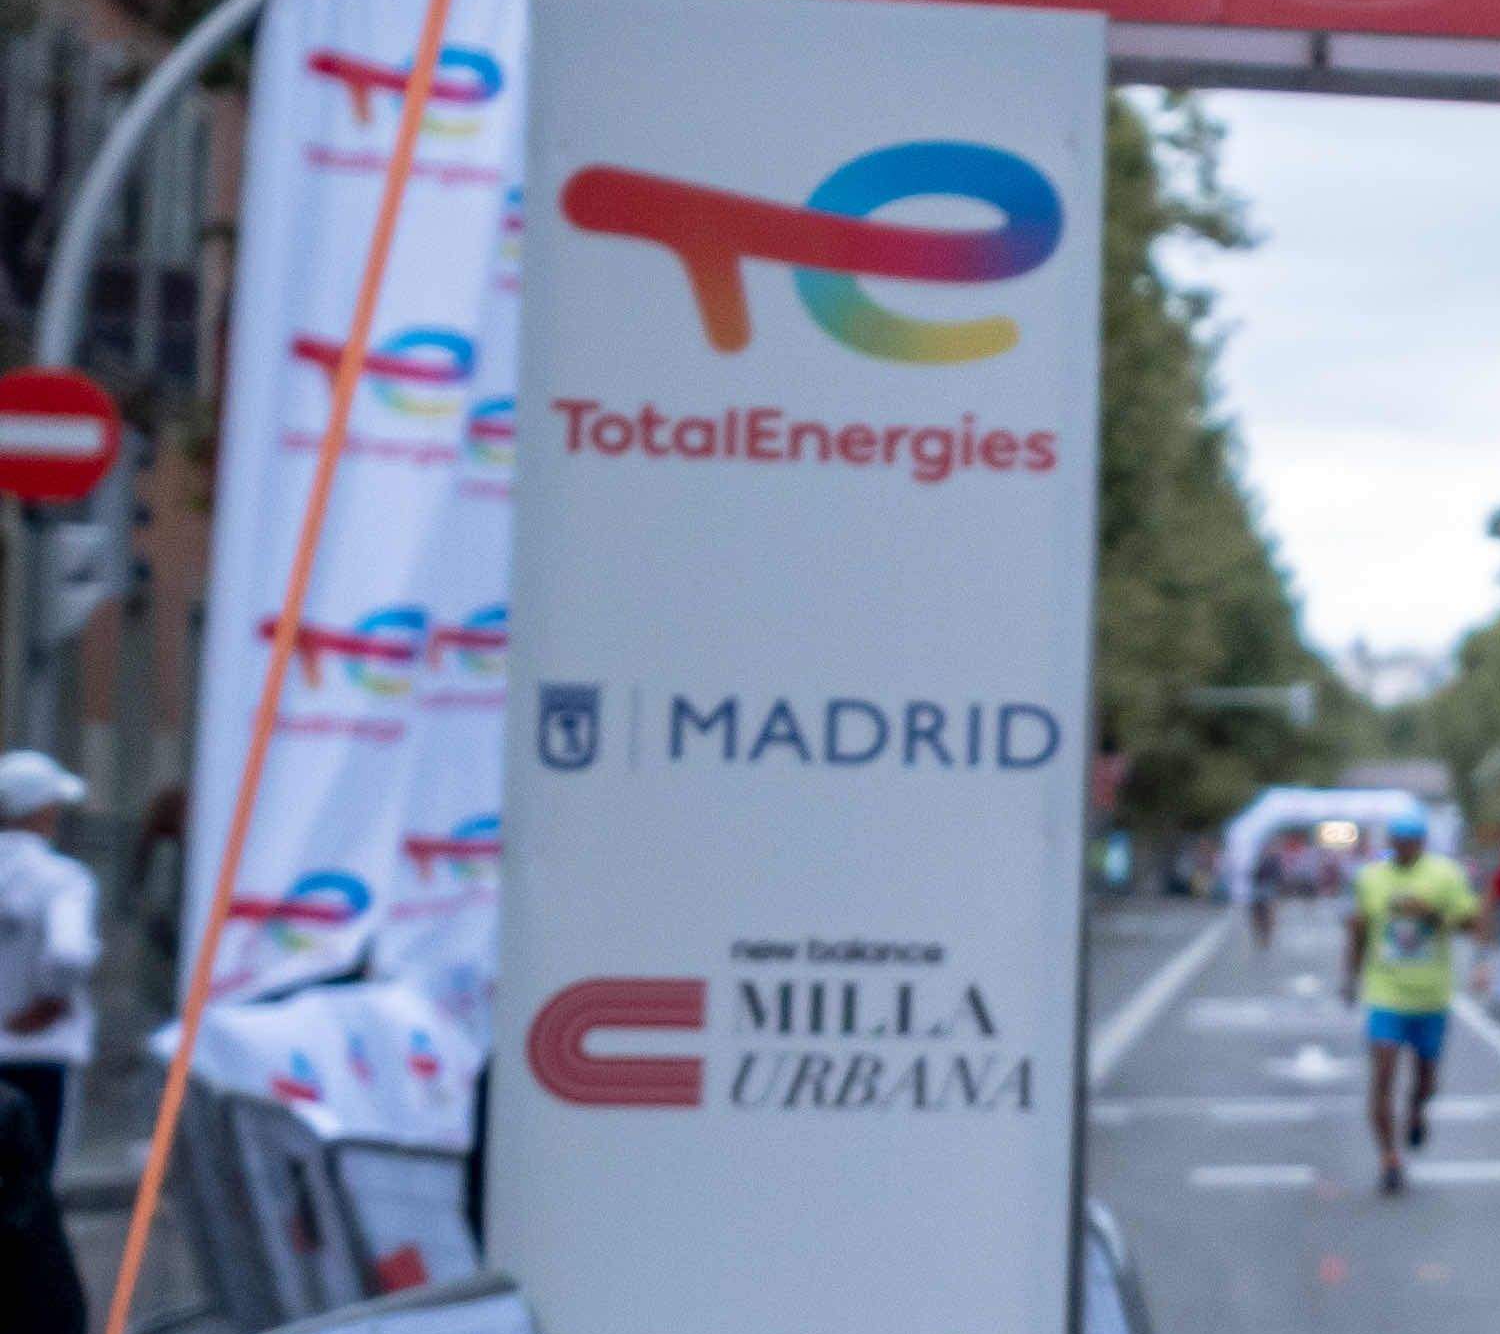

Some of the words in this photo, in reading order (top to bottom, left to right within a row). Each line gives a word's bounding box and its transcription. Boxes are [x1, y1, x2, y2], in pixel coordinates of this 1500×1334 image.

[551, 397, 1058, 484] TotalEnergies
[667, 695, 1061, 769] MADRID
[731, 938, 797, 963] new
[806, 936, 943, 966] balance
[737, 979, 996, 1039] MILLA
[730, 1051, 1038, 1112] URBANA
